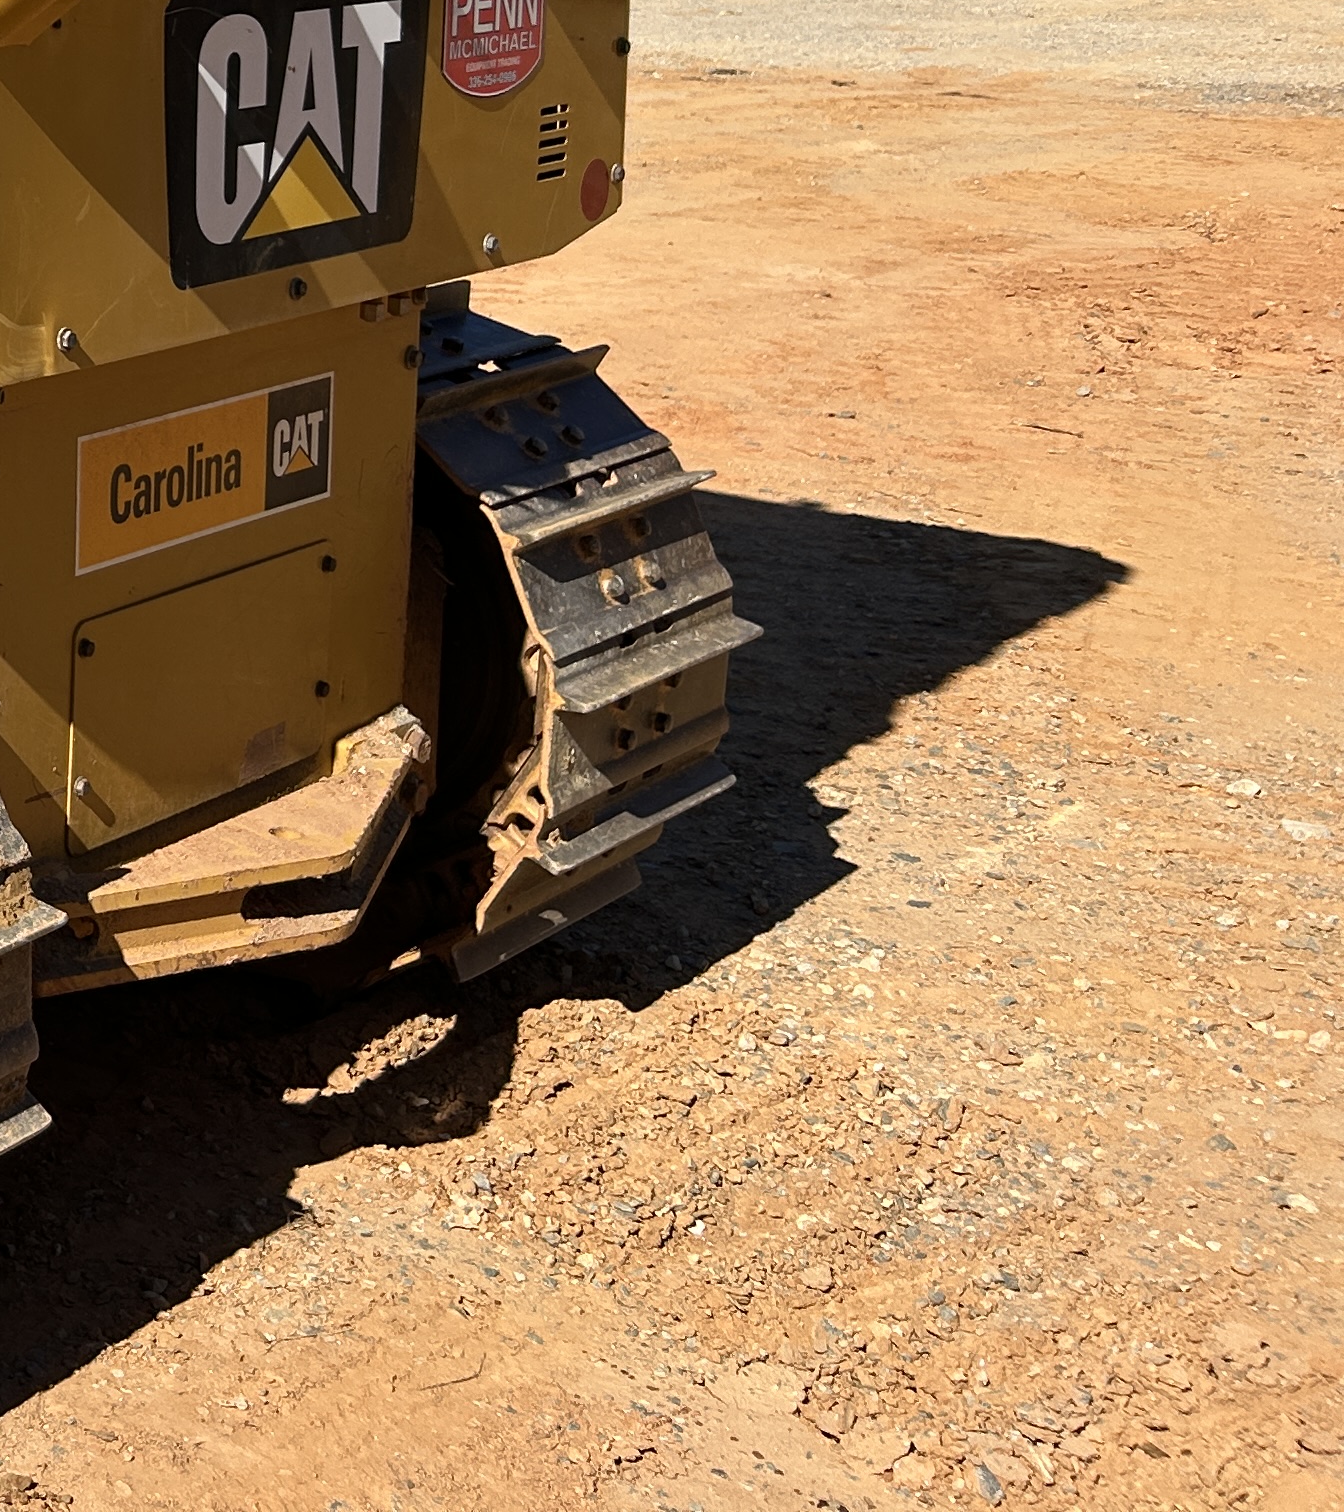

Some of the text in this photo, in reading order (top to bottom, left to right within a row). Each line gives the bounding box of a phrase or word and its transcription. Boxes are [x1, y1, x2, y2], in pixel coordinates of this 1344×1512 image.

[449, 31, 538, 60] MCMICHAEL
[195, 0, 403, 245] CAT
[110, 409, 326, 525] Carolina CAT
